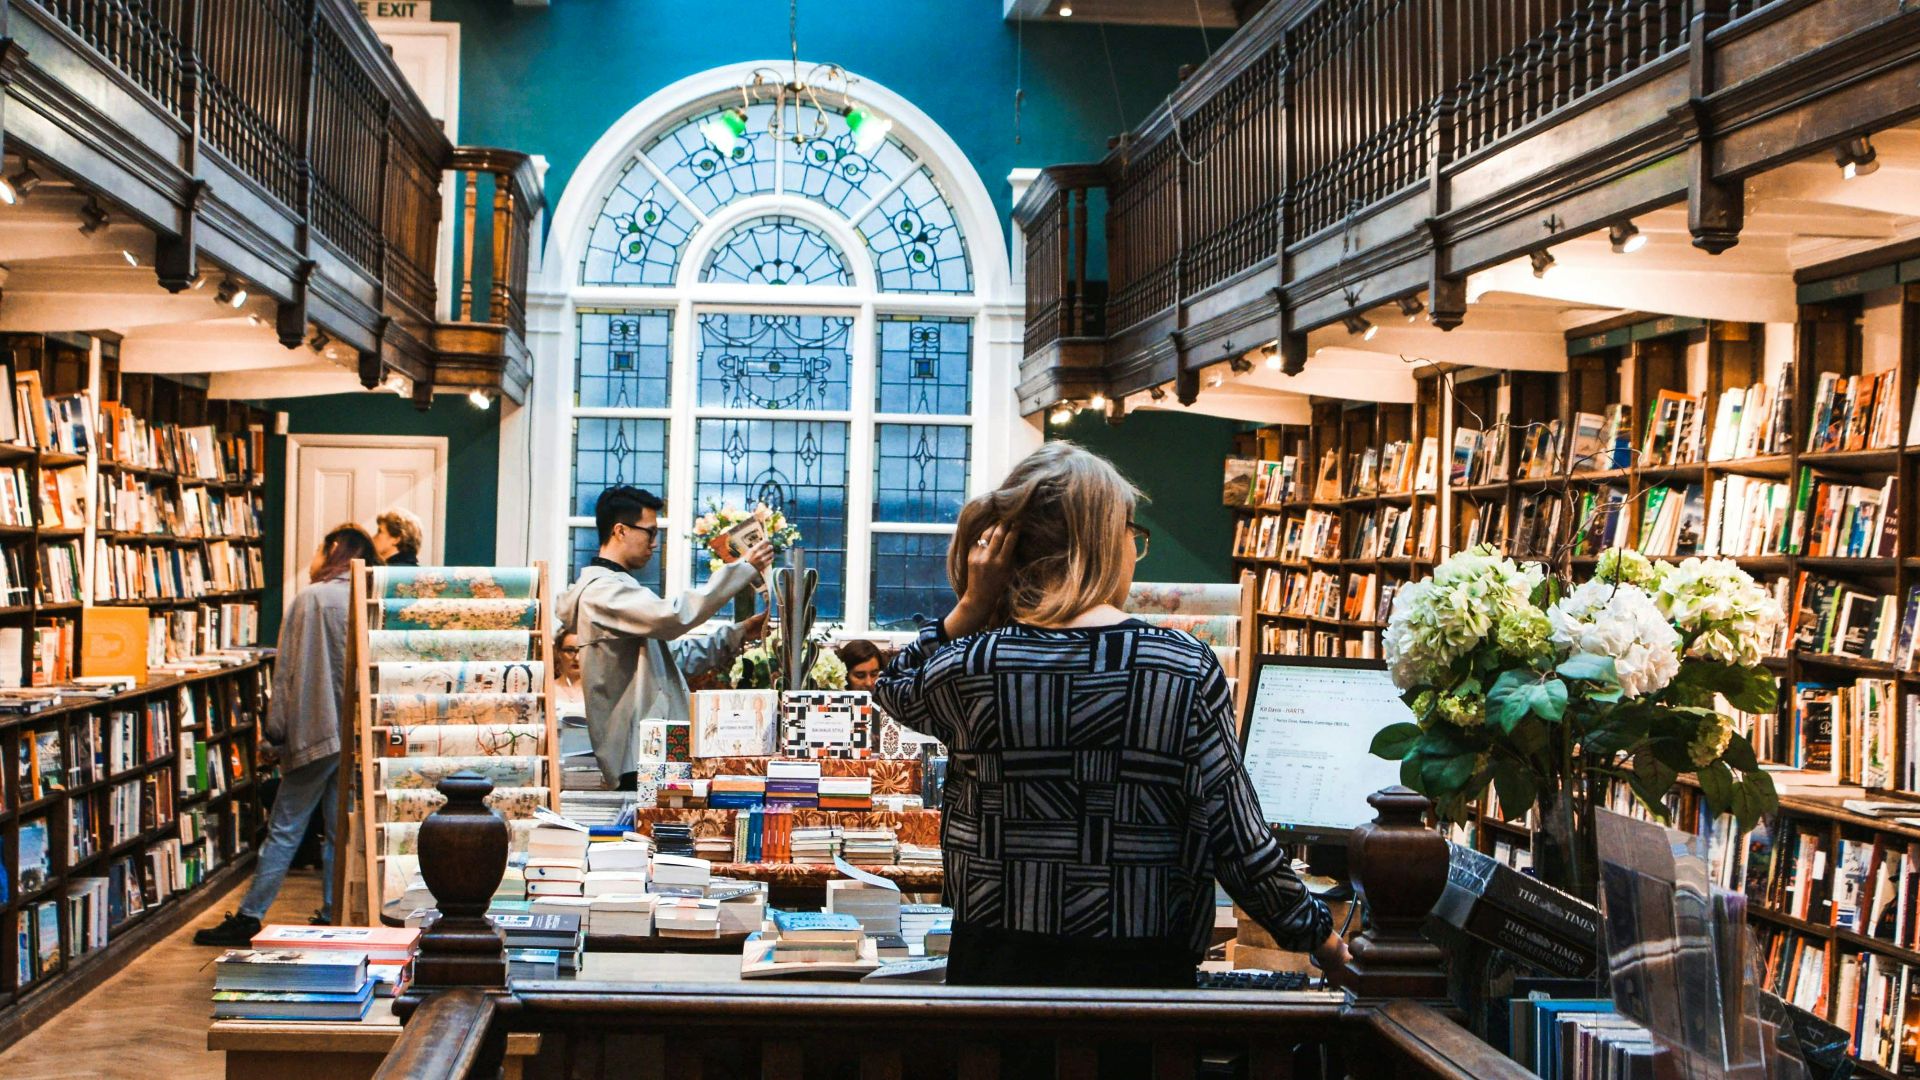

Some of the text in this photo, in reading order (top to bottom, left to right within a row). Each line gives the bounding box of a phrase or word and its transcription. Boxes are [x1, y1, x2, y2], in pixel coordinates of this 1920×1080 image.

[377, 2, 418, 18] EXIT
[1518, 888, 1597, 933] THE TIMES
[1498, 931, 1580, 976] COMPREHENSIVE
[1504, 919, 1585, 965] THE TIMES
